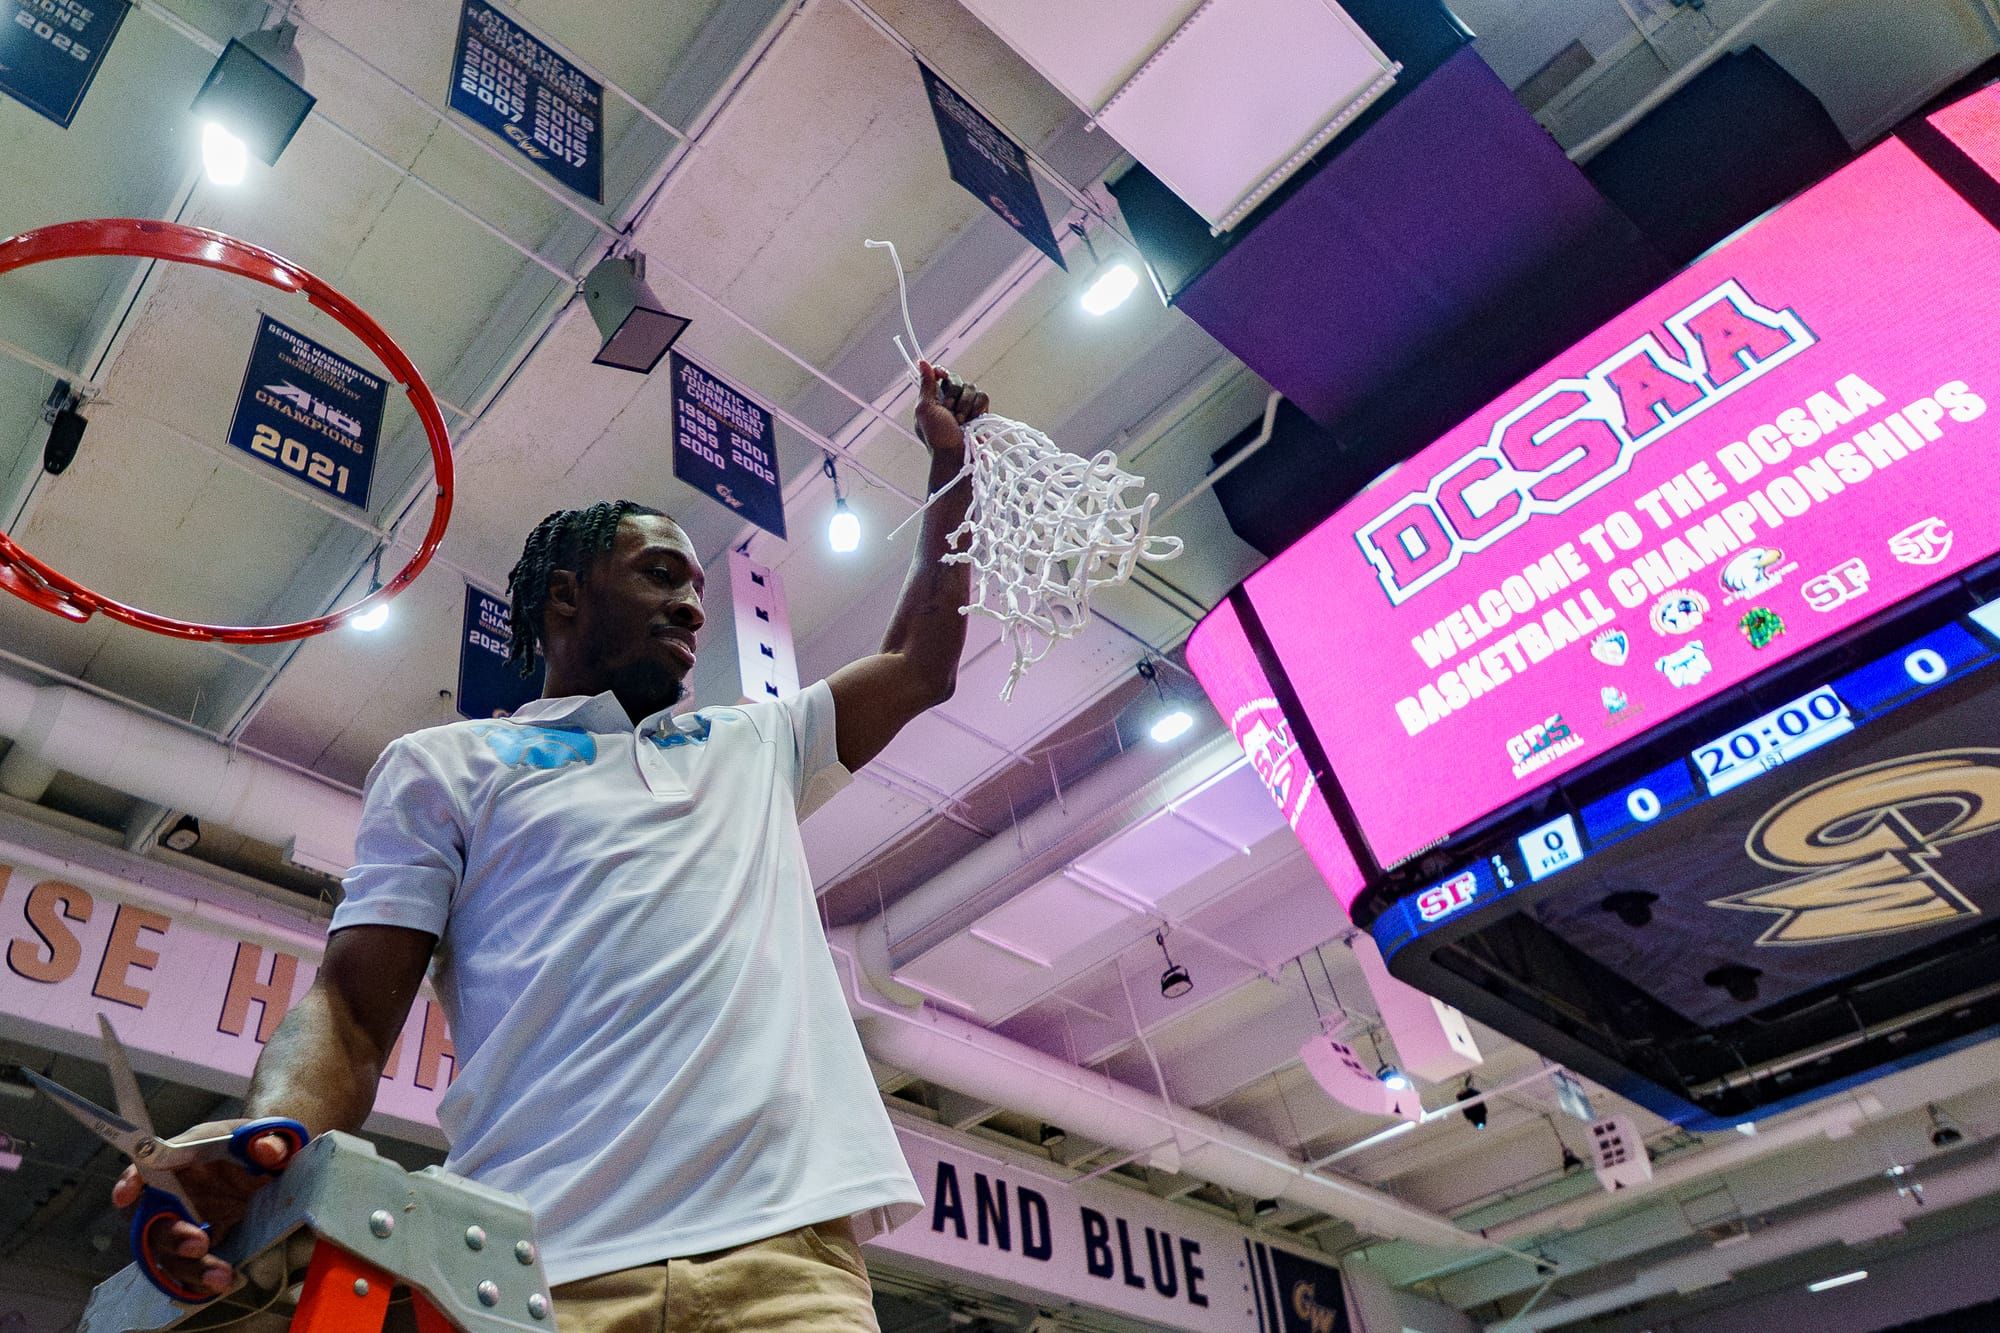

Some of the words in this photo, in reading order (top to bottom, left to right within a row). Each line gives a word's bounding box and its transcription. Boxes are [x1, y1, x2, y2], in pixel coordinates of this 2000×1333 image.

[15, 9, 91, 61] 2025
[467, 7, 538, 60] REGULAR
[539, 59, 598, 105] SEASON
[483, 9, 565, 72] ATLANTIC
[568, 69, 586, 87] 10
[483, 26, 583, 104] CHAMPIONS
[463, 63, 525, 113] 2006
[535, 112, 587, 156] 2016
[465, 50, 526, 99] 2005
[536, 99, 588, 142] 2015
[467, 36, 528, 86] 2004
[537, 85, 595, 132] 2008
[460, 77, 523, 123] 2007
[534, 126, 587, 168] 2017
[268, 323, 310, 354] GEORGE
[312, 347, 379, 390] WASHINGTON
[292, 346, 354, 385] UNIVERSITY
[255, 389, 364, 454] CHAMPIONS
[680, 370, 765, 432] TOURNAMENT
[682, 364, 745, 410] ATLANTIC
[747, 404, 761, 421] 10
[686, 384, 761, 440] CHAMPIONS
[251, 423, 350, 494] 2021
[678, 398, 718, 432] 1998
[730, 432, 769, 466] 2001
[679, 415, 719, 449] 1999
[731, 449, 776, 486] 2002
[679, 432, 726, 470] 2000
[1356, 278, 1819, 606] DCSAA
[1411, 543, 1591, 669] WELCOME
[1579, 504, 1643, 564] TO
[1634, 460, 1728, 527] THE
[1715, 373, 1886, 485] DCSAA
[1889, 517, 1953, 565] SJC
[1395, 580, 1616, 737] BASKETBALL
[1607, 380, 1987, 609] CHAMPIONSHIPS
[1801, 557, 1871, 612] SF
[480, 598, 512, 620] ATLA
[469, 630, 511, 658] 2023
[1904, 648, 1948, 684] 0
[1505, 713, 1571, 763] GDS
[1699, 693, 1841, 777] 20:00
[1627, 788, 1661, 821] 0
[1543, 831, 1564, 850] 0
[1417, 870, 1477, 921] SF
[931, 1160, 1053, 1262] AND
[1080, 1206, 1209, 1308] BLUE
